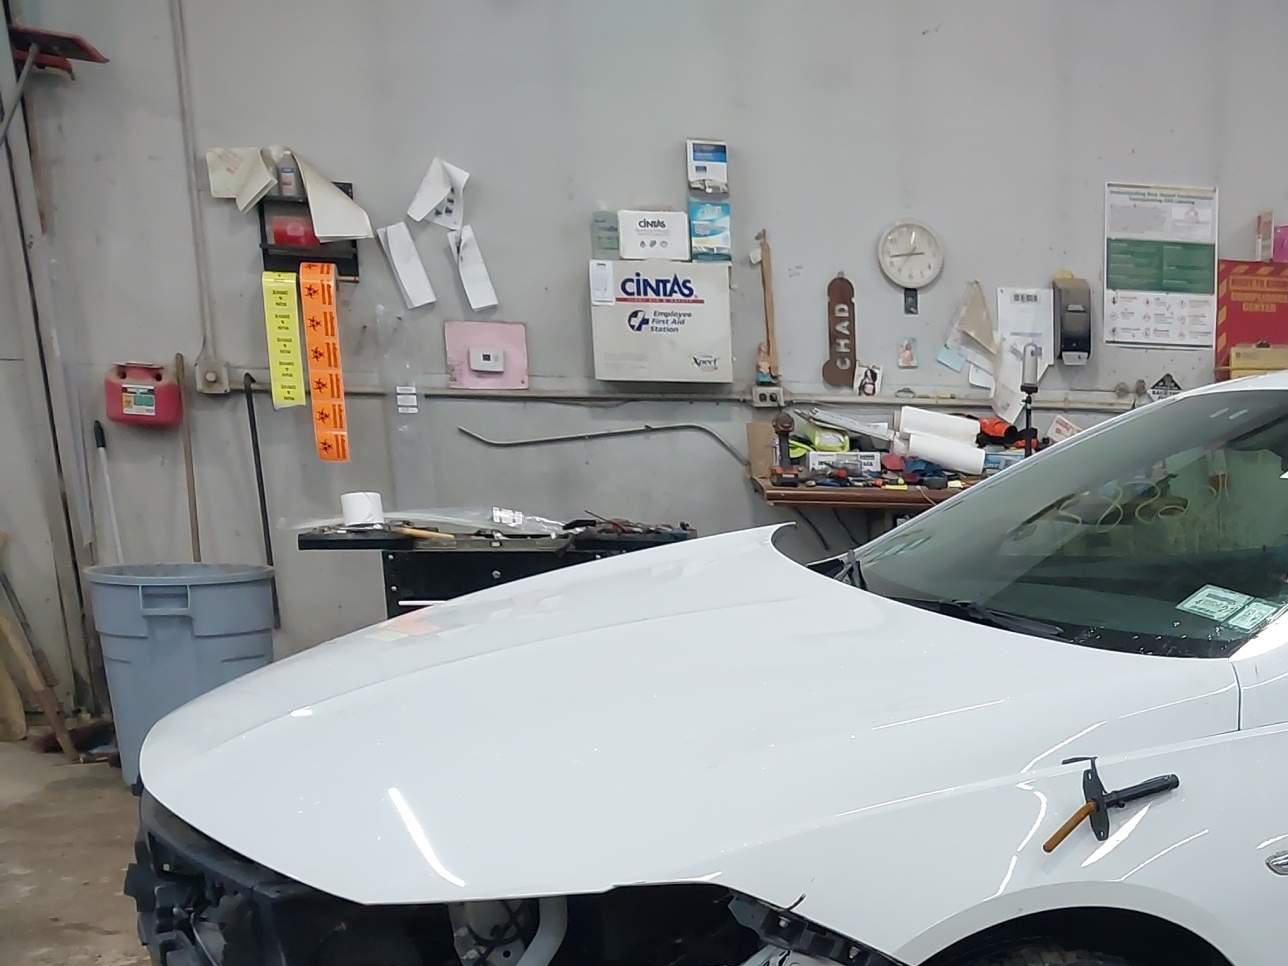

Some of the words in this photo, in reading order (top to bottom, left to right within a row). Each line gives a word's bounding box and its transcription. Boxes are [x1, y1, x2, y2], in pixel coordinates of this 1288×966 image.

[620, 271, 695, 298] CINTAS
[653, 310, 692, 320] Employee
[651, 318, 672, 326] First
[650, 325, 679, 333] Station
[835, 303, 851, 370] CHAD
